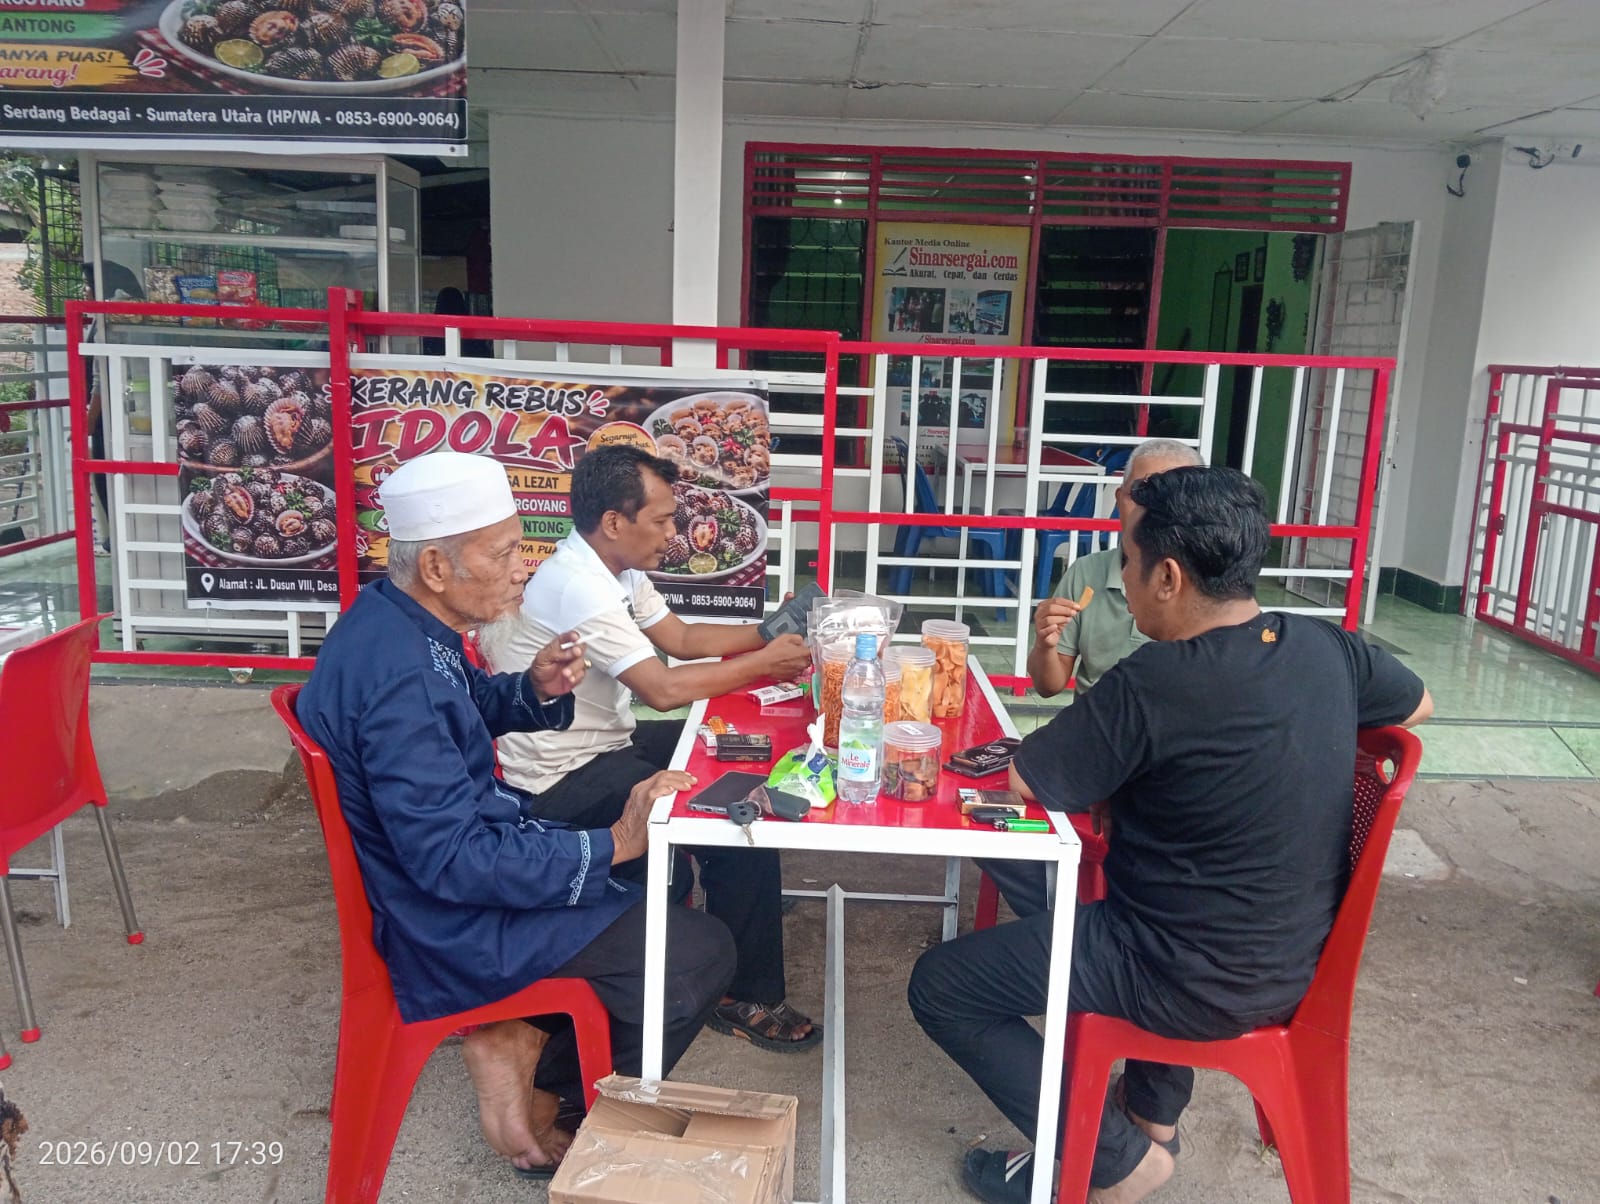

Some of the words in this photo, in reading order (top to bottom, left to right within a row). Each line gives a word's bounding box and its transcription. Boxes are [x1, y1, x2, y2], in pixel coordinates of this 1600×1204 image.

[56, 50, 114, 63] PUAS!
[3, 104, 66, 122] Serdang
[70, 106, 131, 124] Bedagai
[146, 107, 217, 122] Sumatera
[266, 109, 321, 126] (HP/WA
[335, 110, 460, 129] 0853-6900-9064)
[884, 237, 913, 245] Kantor
[915, 238, 941, 247] Media
[943, 239, 970, 248] Online
[909, 246, 1018, 272] Sinarsergai.com
[972, 271, 988, 280] dan
[351, 376, 477, 407] KERANG
[484, 383, 584, 416] REBUS
[351, 408, 588, 469] IDOLA
[524, 475, 560, 489] LEZAT
[218, 578, 248, 591] Alamat
[255, 579, 268, 591] JL.
[270, 580, 297, 592] Dusun
[317, 580, 338, 592] Desa
[691, 594, 757, 610] 0853-6900-9064)
[850, 752, 860, 761] Le
